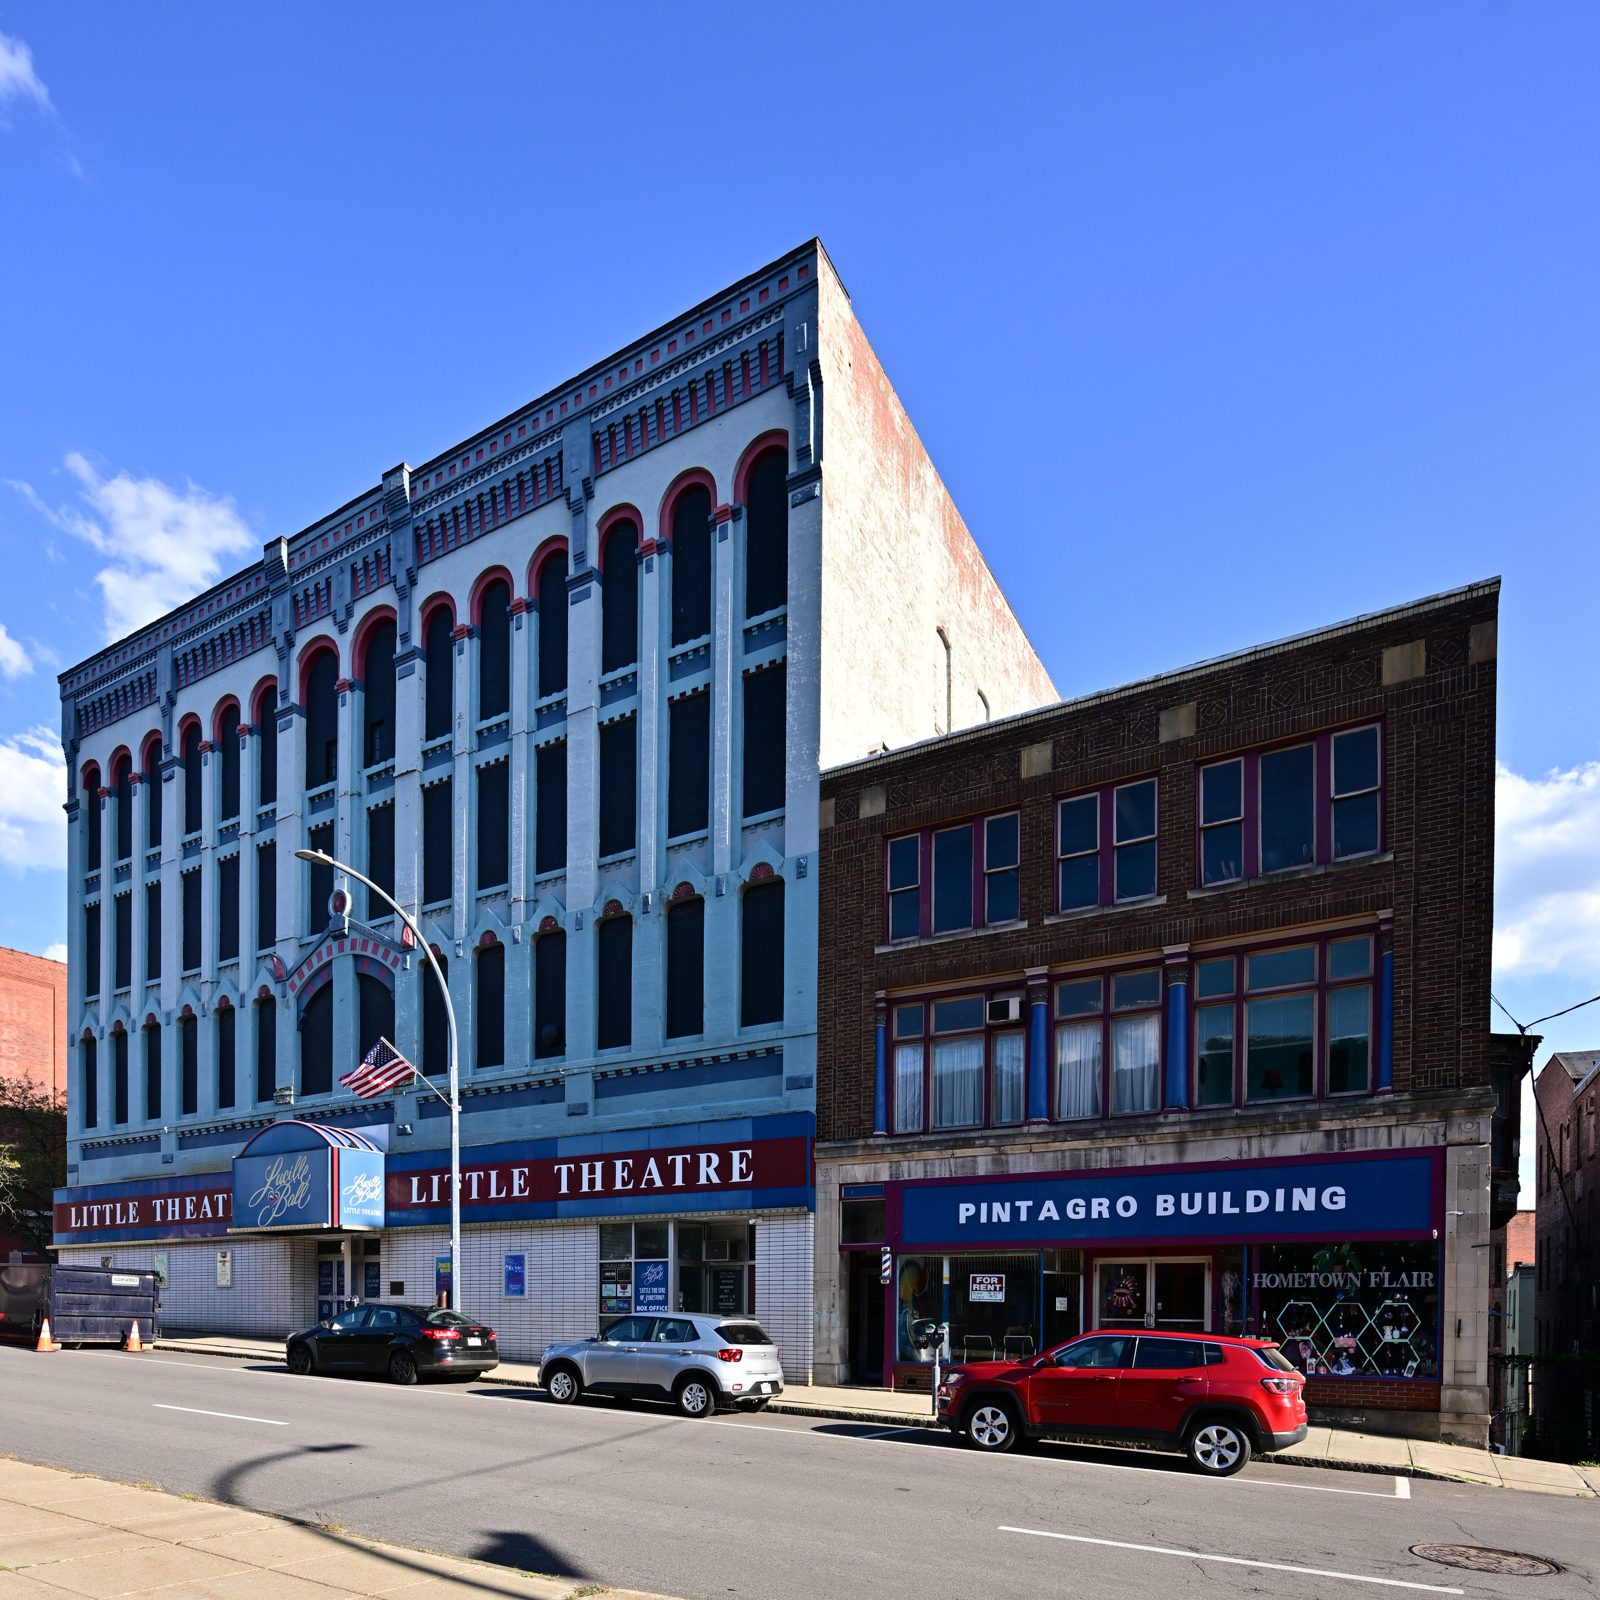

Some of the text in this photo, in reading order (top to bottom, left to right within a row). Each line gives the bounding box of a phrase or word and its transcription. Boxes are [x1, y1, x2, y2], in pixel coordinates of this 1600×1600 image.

[249, 1156, 311, 1207] Lucille
[554, 1149, 754, 1194] THEATRE
[69, 1193, 232, 1228] LITTLE THEAT
[258, 1183, 310, 1227] Ball
[958, 1186, 1347, 1224] PINTAGRO BUILDING
[972, 1283, 1002, 1291] RENT
[976, 1276, 998, 1284] FOR
[1253, 1271, 1435, 1288] HOMETOWN FLAIR
